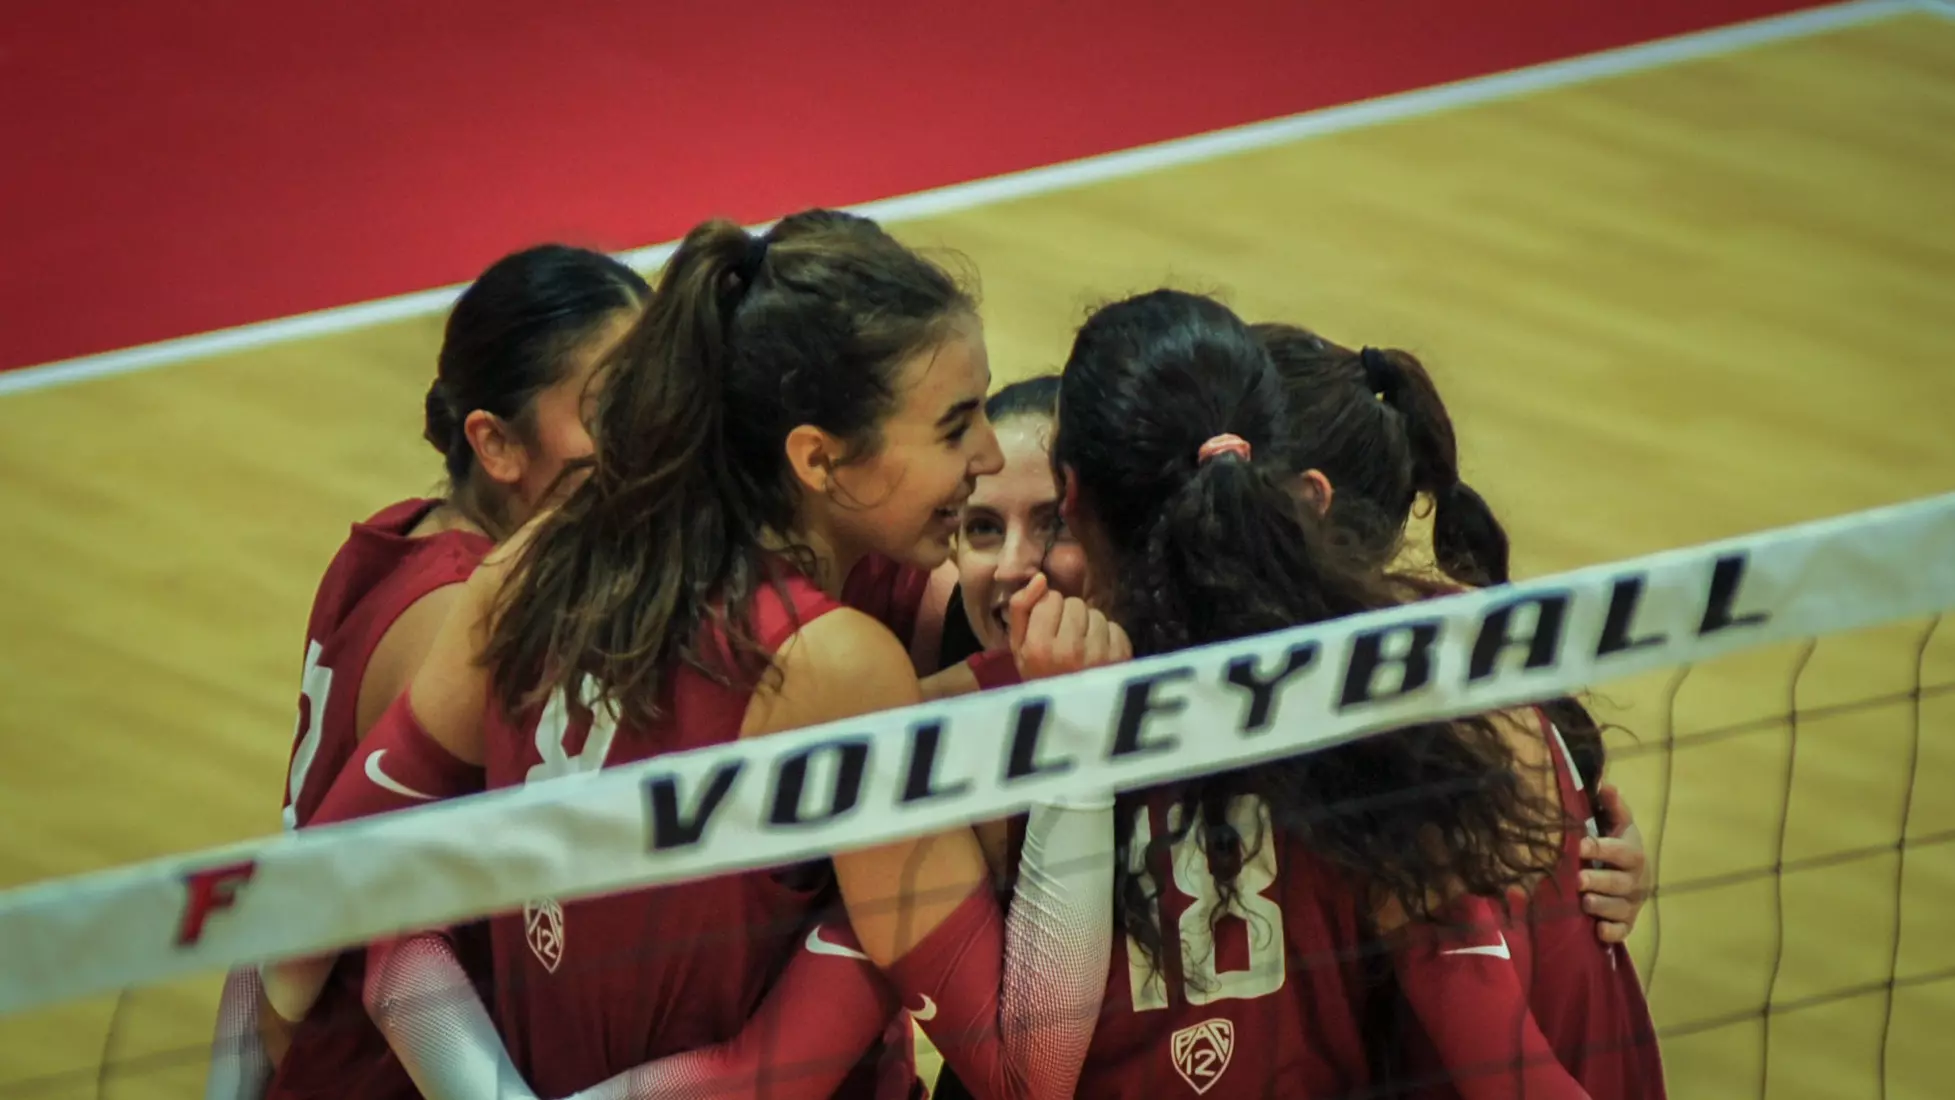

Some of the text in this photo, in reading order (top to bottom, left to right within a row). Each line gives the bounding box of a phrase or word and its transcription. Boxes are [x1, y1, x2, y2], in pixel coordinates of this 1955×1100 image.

[643, 552, 1770, 851] VOLLEYBALL
[175, 859, 255, 948] F
[1125, 793, 1285, 1012] 18
[536, 926, 557, 959] 12
[1175, 1022, 1230, 1064] PAC
[1186, 1049, 1217, 1076] 12
